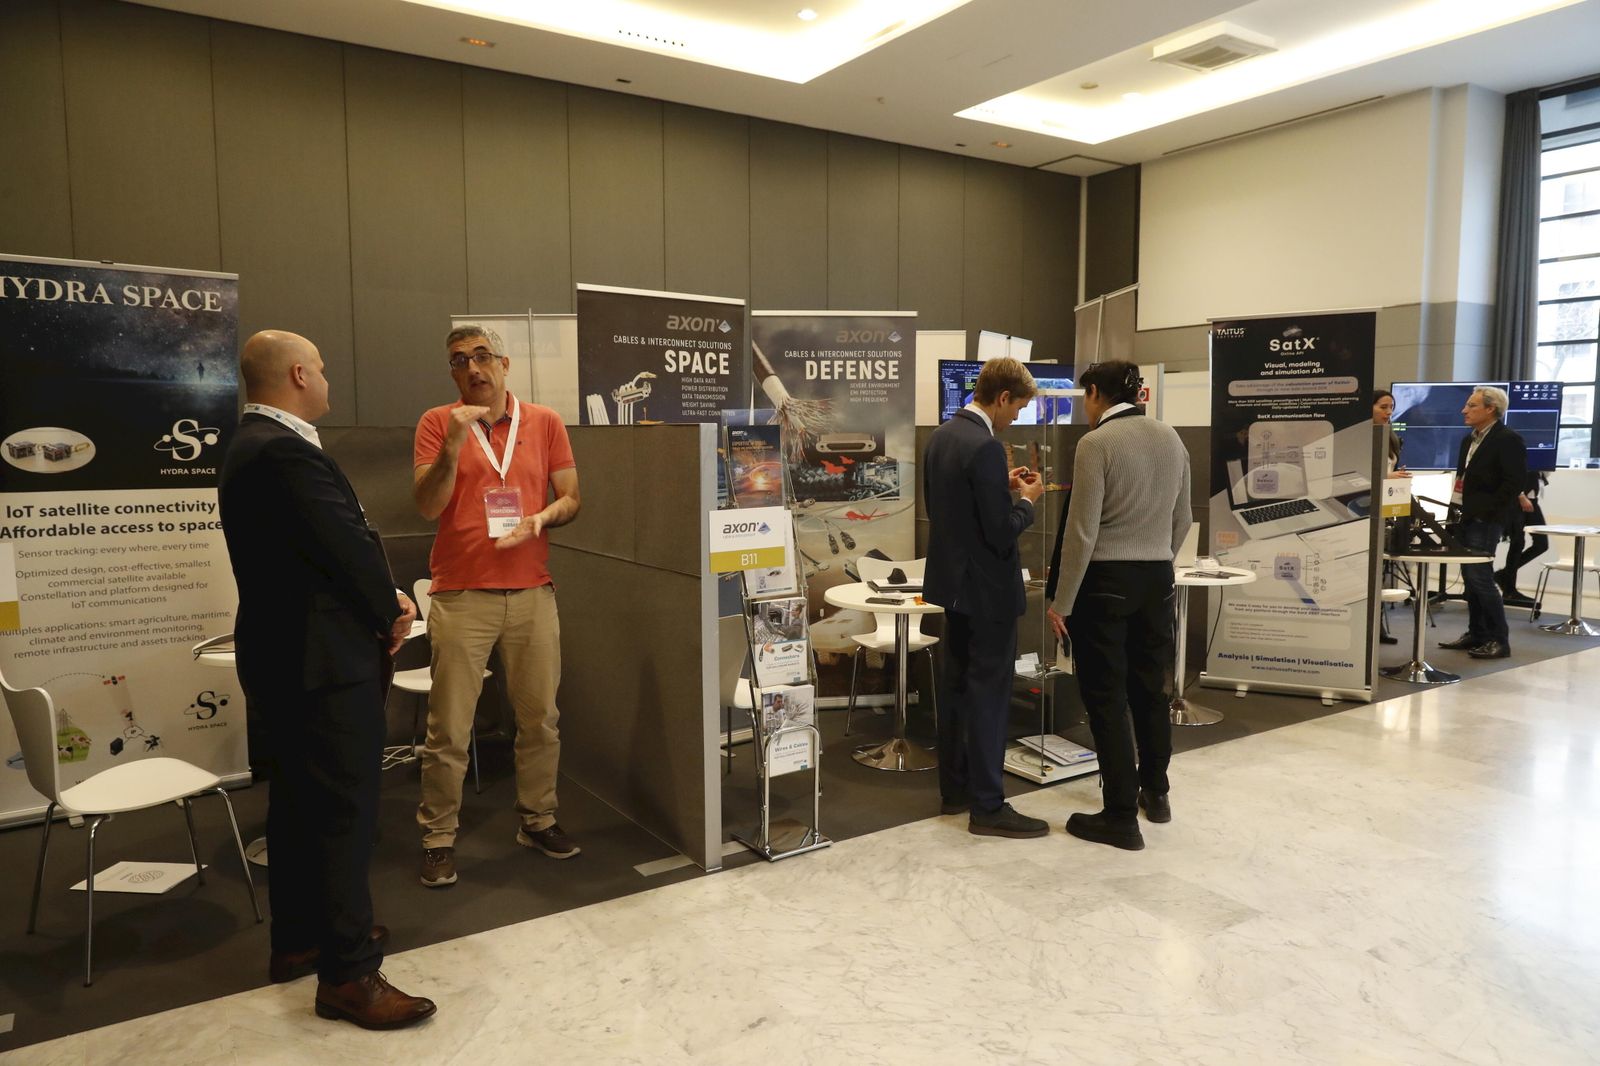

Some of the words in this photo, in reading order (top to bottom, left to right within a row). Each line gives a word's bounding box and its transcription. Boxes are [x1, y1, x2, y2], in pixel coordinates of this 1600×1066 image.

[123, 284, 223, 312] SPACE
[613, 334, 639, 345] CABLES
[640, 337, 646, 345] &
[647, 337, 697, 348] INTERCONNECT
[697, 341, 732, 351] SOLUTIONS
[664, 349, 730, 375] SPACE
[784, 350, 809, 358] CABLES
[817, 350, 866, 358] INTERCONNECT
[867, 350, 902, 358] SOLUTIONS
[805, 360, 900, 380] DEFENSE
[1274, 368, 1311, 376] simulation
[1288, 360, 1321, 368] modeling
[160, 467, 190, 476] HYDRA
[191, 467, 217, 475] SPACE
[6, 505, 35, 518] IoT
[39, 502, 110, 518] satellite
[114, 500, 216, 514] connectivity
[0, 522, 97, 539] Affordable
[100, 522, 154, 535] access
[158, 521, 175, 533] to
[179, 520, 224, 534] space
[18, 549, 53, 559] Sensor
[55, 546, 99, 557] tracking:
[100, 546, 127, 555] every
[129, 543, 161, 553] where,
[162, 543, 188, 552] every
[189, 541, 210, 550] time
[741, 552, 758, 566] B11
[15, 567, 68, 580] Optimized
[70, 565, 106, 576] design,
[108, 561, 173, 574] cost-effective,
[175, 559, 211, 569] smallest
[47, 576, 105, 588] commercial
[108, 574, 144, 585] satellite
[146, 571, 187, 582] available
[20, 590, 87, 602] Constellation
[89, 587, 107, 596] and
[110, 585, 151, 596] platform
[152, 582, 195, 593] designed
[195, 581, 208, 590] for
[71, 600, 87, 609] IoT
[88, 595, 167, 609] communications
[44, 620, 107, 634] applications:
[108, 617, 135, 627] smart
[138, 614, 190, 626] agriculture,
[29, 634, 66, 646] climate
[68, 631, 87, 641] and
[89, 628, 150, 640] environment
[14, 647, 51, 660] remote
[53, 641, 119, 655] infrastructure
[120, 639, 139, 649] and
[140, 637, 168, 647] assets
[1217, 652, 1249, 661] Analysis
[1255, 655, 1296, 664] Simulation
[1302, 658, 1354, 668] Visualisation
[187, 724, 208, 732] HYDRA
[210, 721, 227, 729] SPACE
